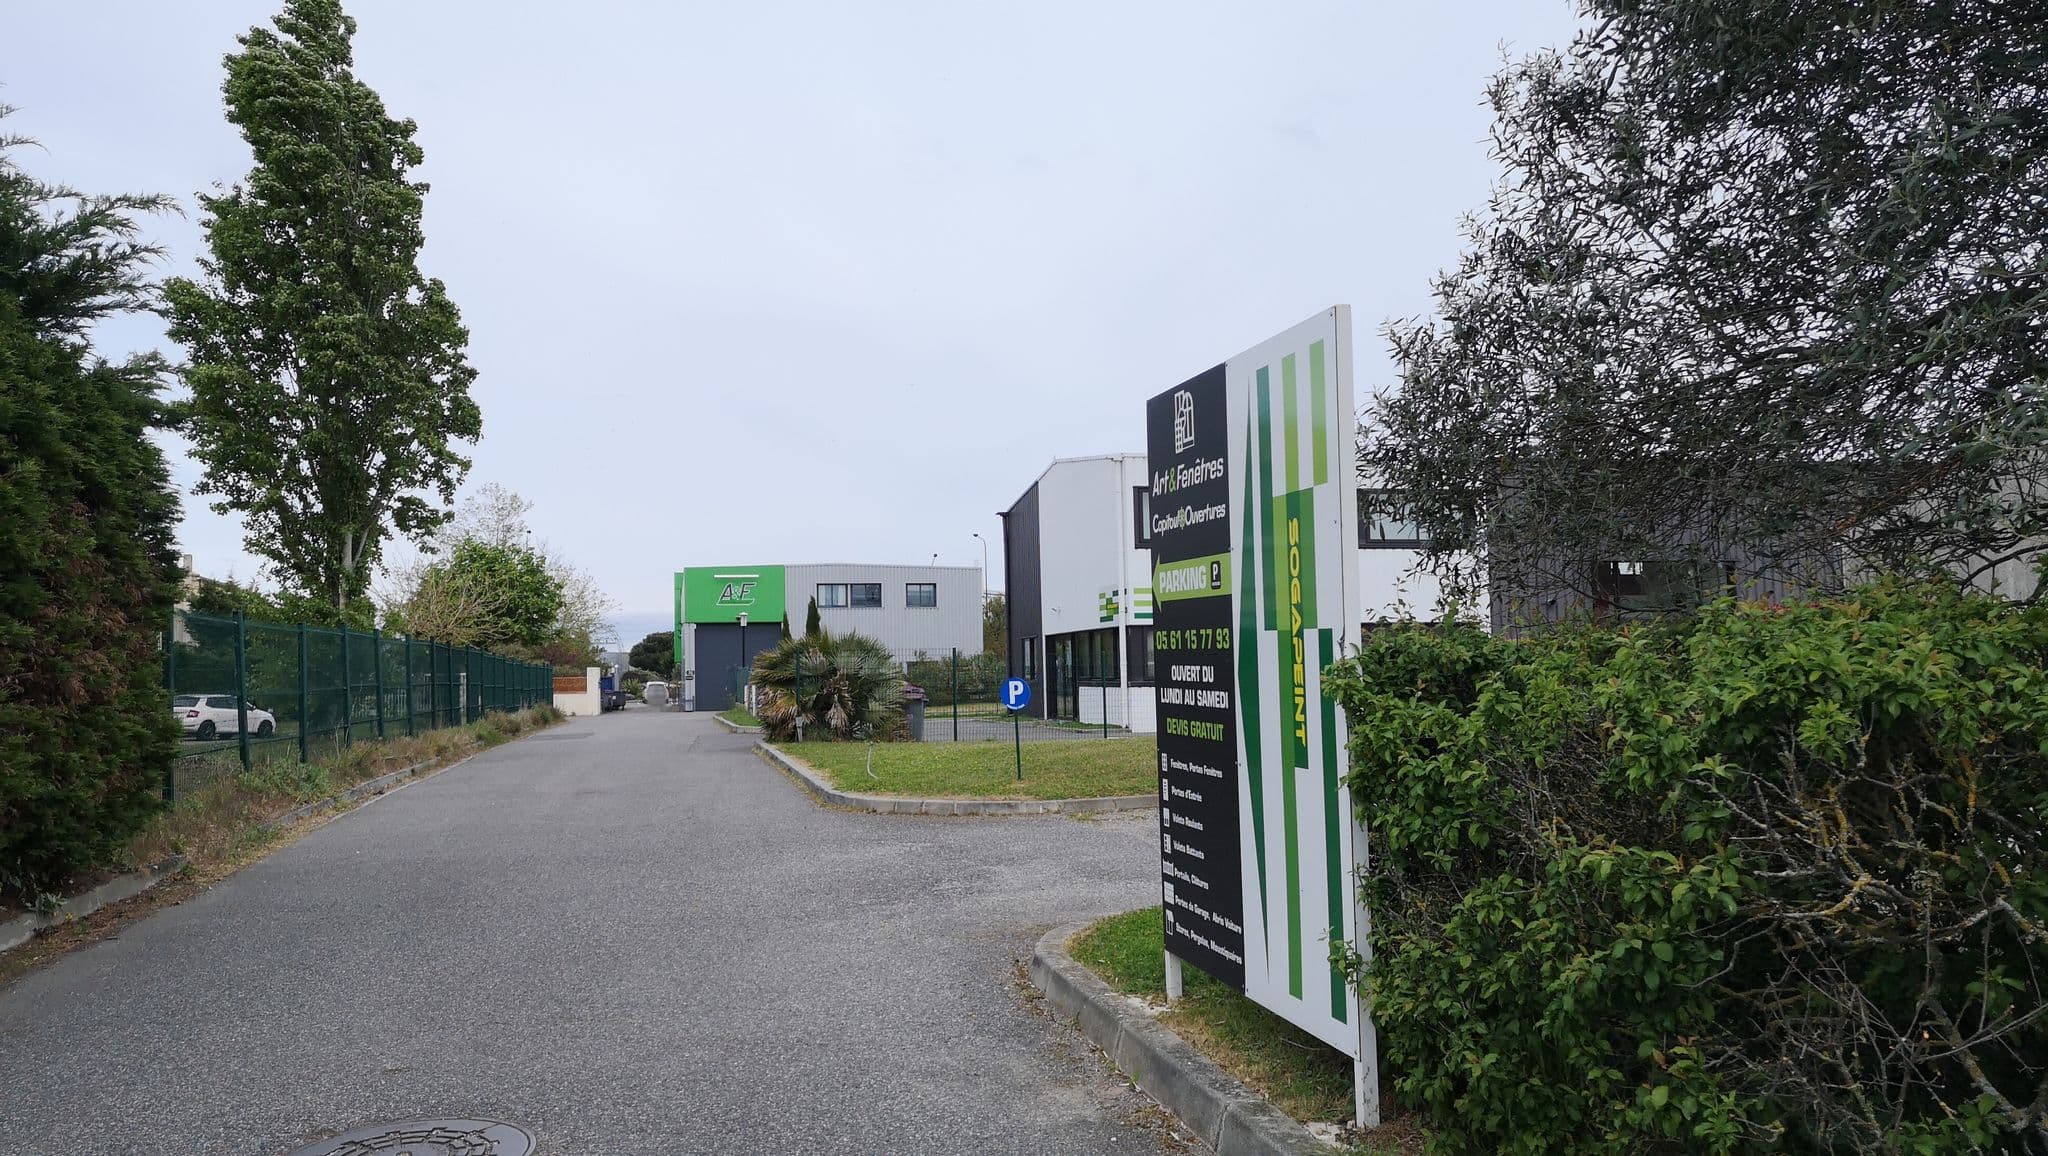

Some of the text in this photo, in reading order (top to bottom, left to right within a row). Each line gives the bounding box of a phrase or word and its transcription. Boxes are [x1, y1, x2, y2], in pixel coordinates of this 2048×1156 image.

[1160, 565, 1206, 593] PARKING
[1156, 628, 1230, 650] 05 61 15 77 93
[1288, 517, 1306, 748] SOGAPEINT
[1171, 665, 1214, 683] OUVERT DU
[1009, 680, 1024, 705] P
[1161, 687, 1229, 709] LUNDI AU SAMEDI
[1166, 717, 1224, 741] DEVIS GRATUIT
